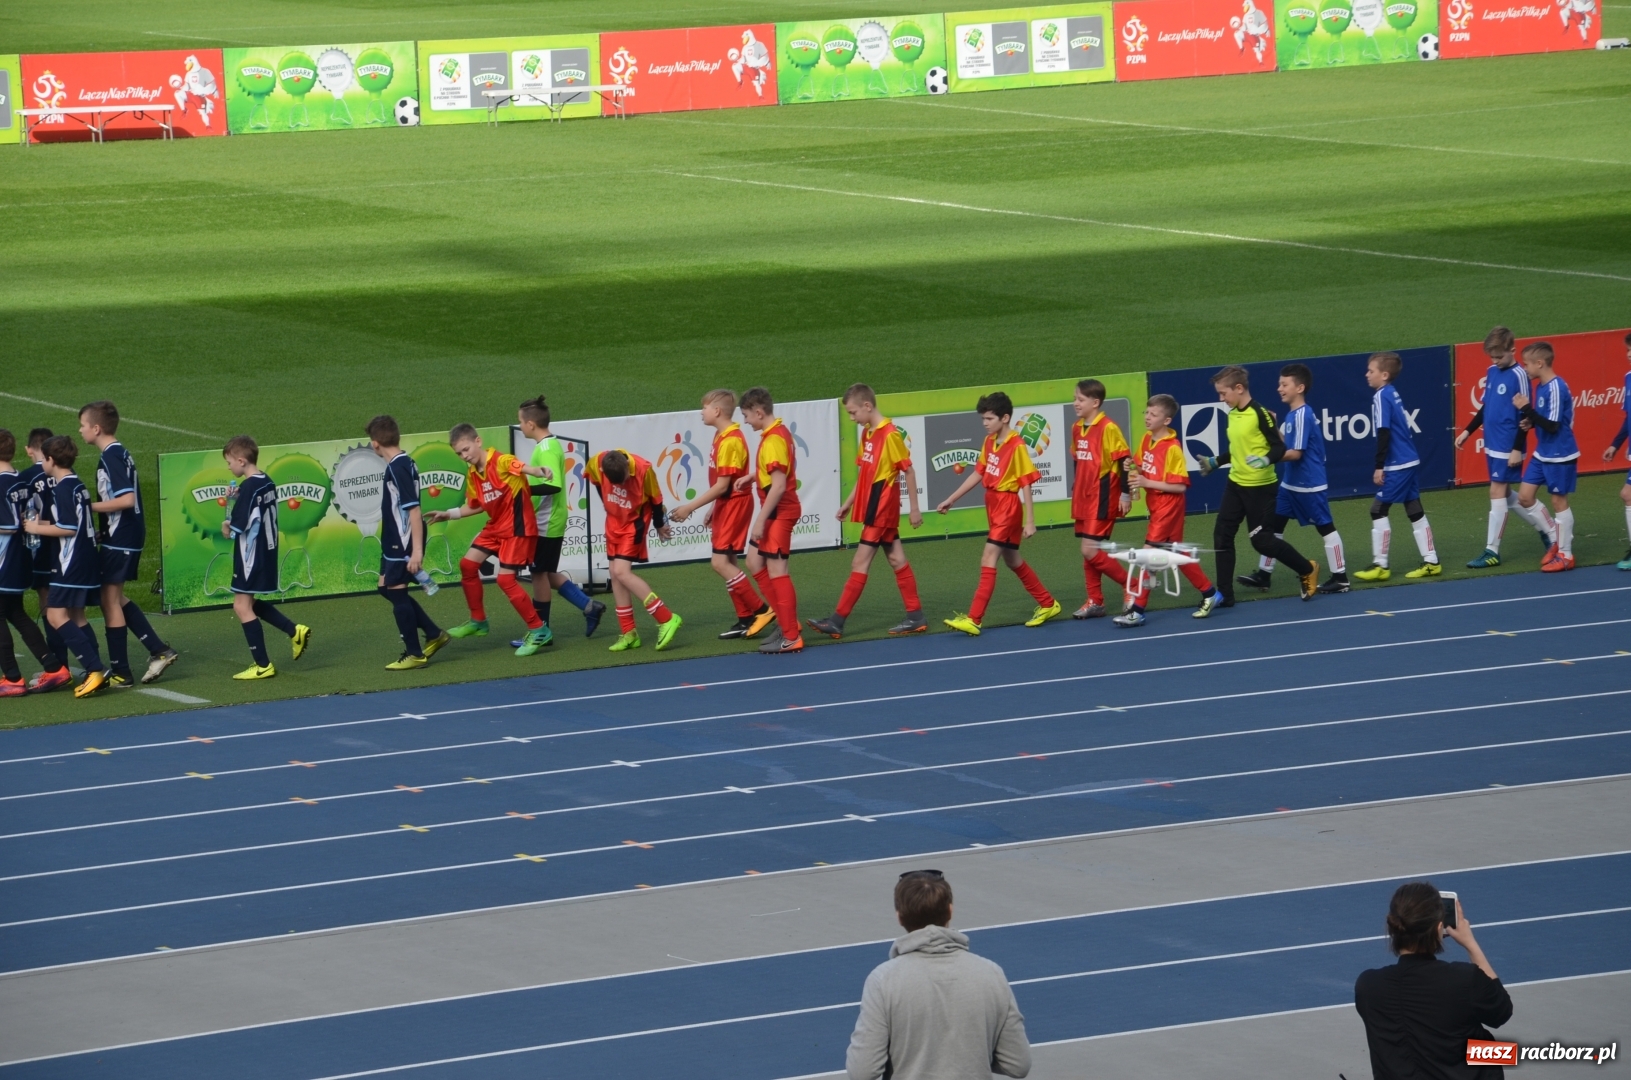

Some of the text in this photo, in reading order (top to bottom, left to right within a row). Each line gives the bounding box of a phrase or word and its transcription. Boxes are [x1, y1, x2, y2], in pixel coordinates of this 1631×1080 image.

[894, 37, 920, 46] TYMBARK
[1449, 32, 1470, 42] PZPN
[826, 41, 852, 51] TYMBARK
[997, 43, 1023, 52] TYMBARK
[1072, 38, 1098, 47] TYMBARK
[1126, 55, 1147, 64] PZPN
[243, 67, 271, 76] TYMBARK
[282, 68, 312, 78] TYMBARK
[359, 65, 389, 75] TYMBARK
[475, 74, 503, 84] TYMBARK
[556, 70, 583, 81] TYMBARK
[421, 473, 462, 487] MBARK
[34, 480, 45, 492] SP
[195, 487, 227, 501] TYMB
[276, 485, 322, 500] YMBARK
[348, 487, 379, 500] TYMBARK
[612, 485, 627, 498] ZSG
[565, 518, 586, 528] EFA
